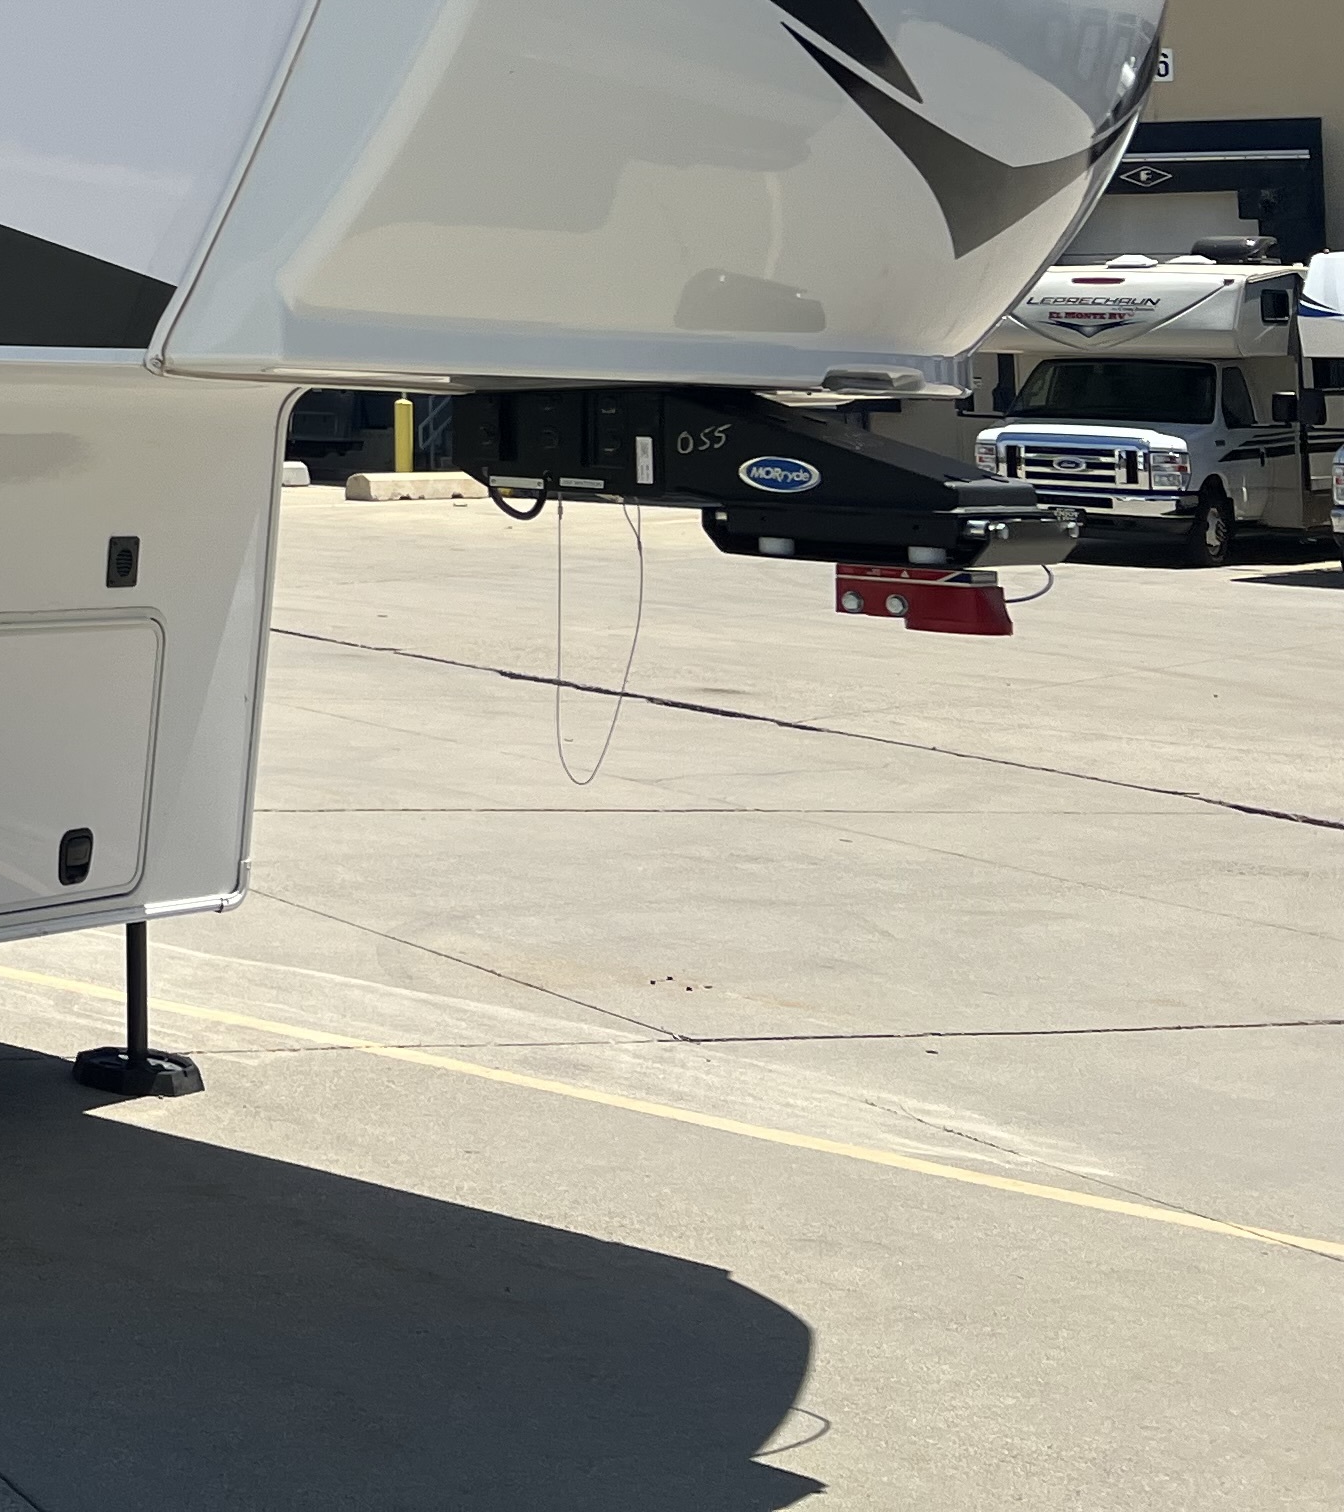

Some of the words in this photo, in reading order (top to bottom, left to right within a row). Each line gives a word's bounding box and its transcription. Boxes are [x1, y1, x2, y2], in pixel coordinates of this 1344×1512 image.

[1026, 296, 1161, 306] LEPRECHAUN
[1048, 311, 1063, 319] EL
[1064, 311, 1106, 319] MONTE
[1108, 311, 1127, 319] RV
